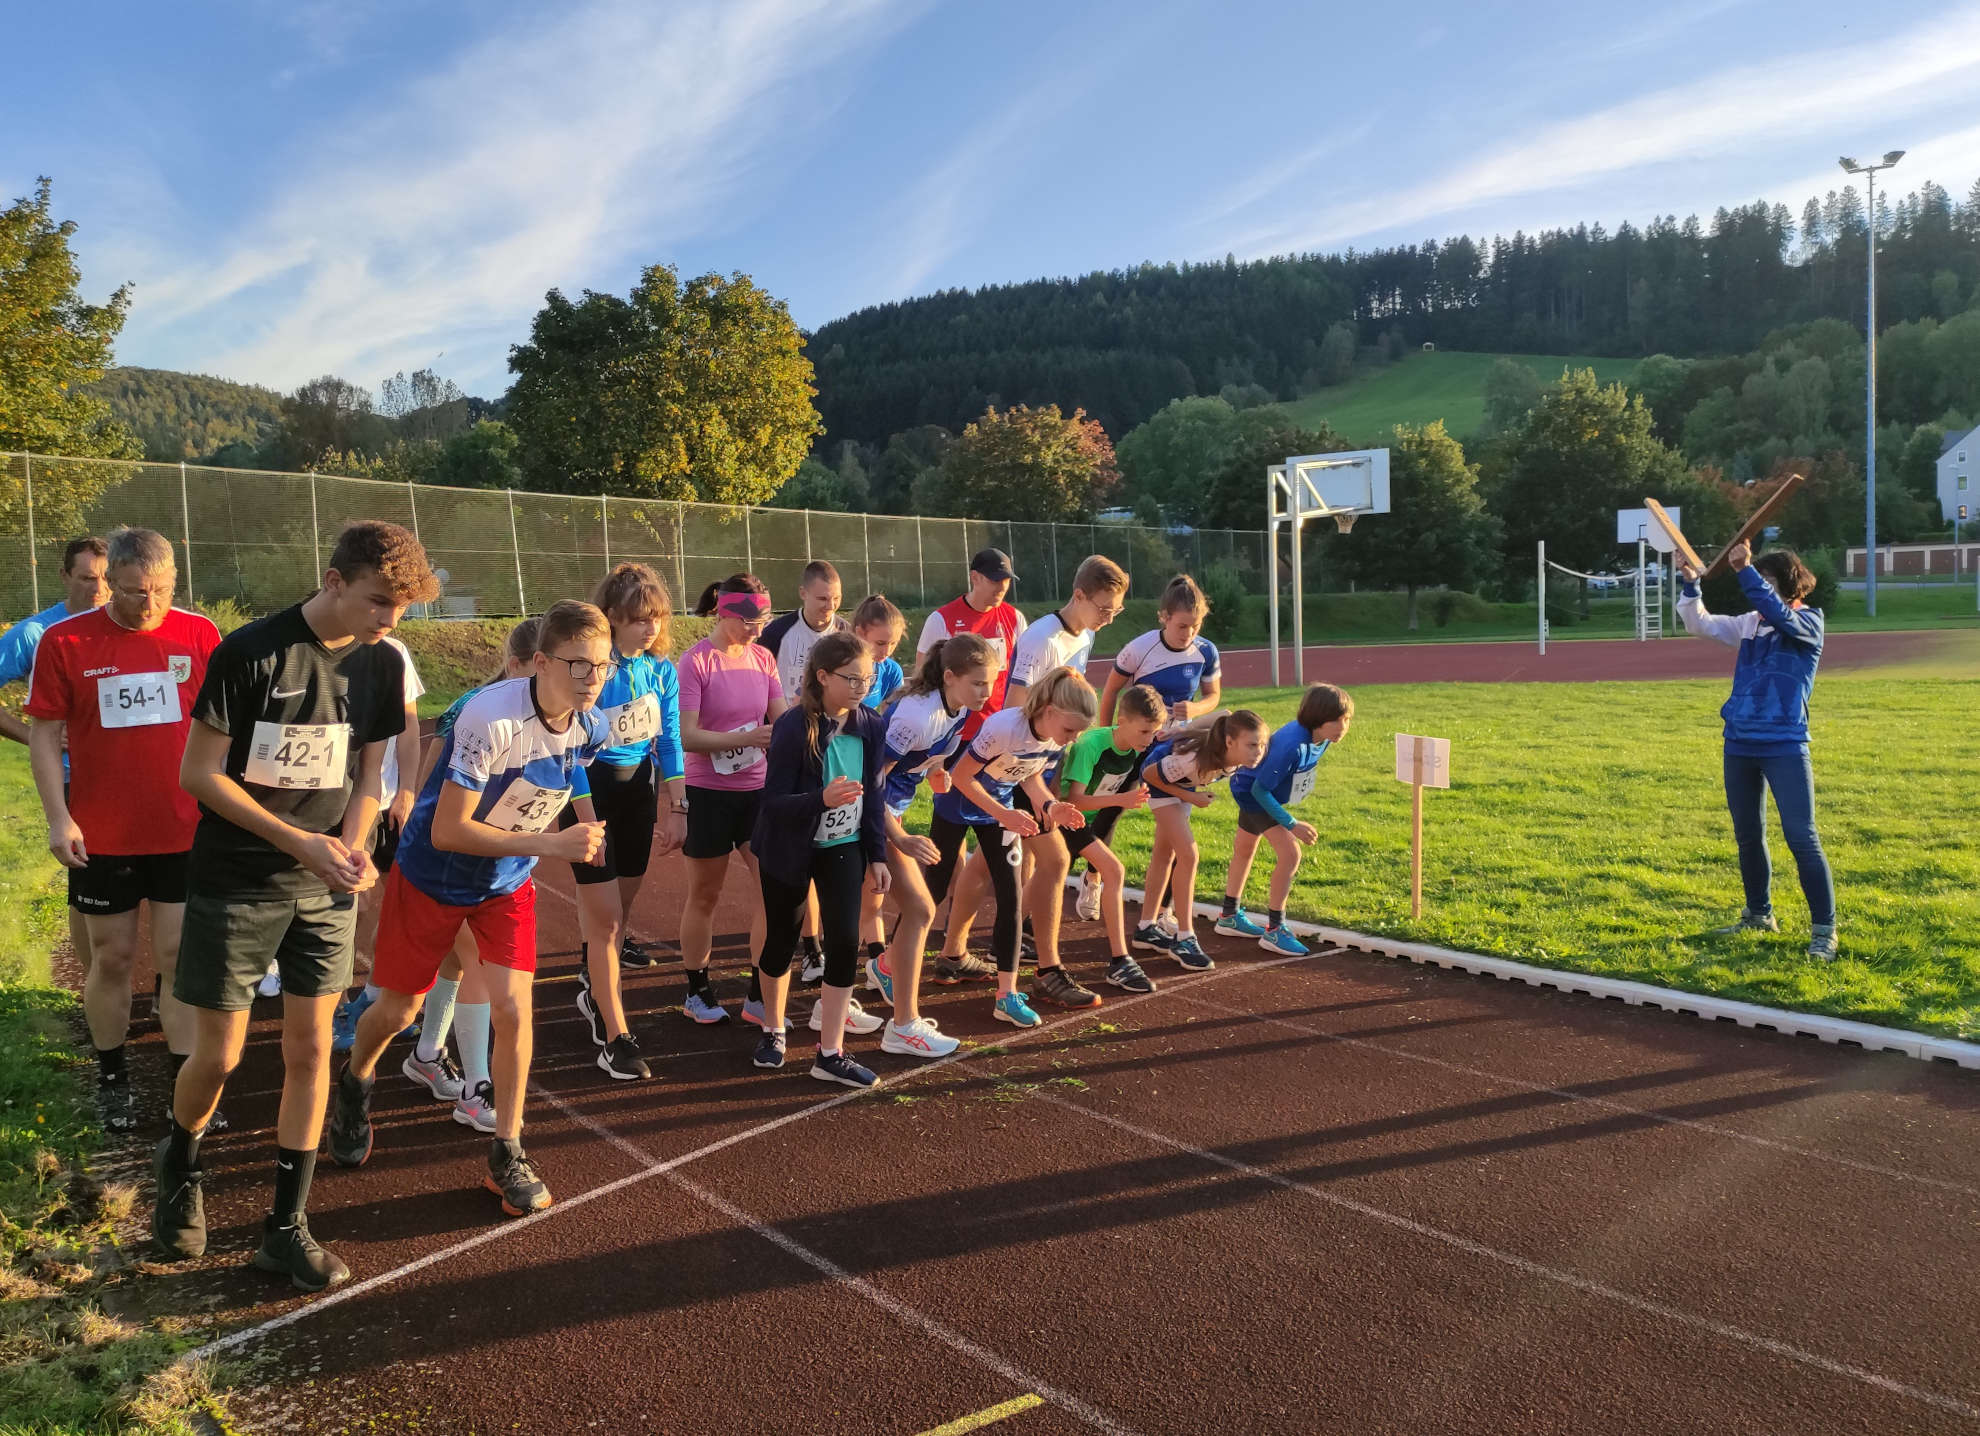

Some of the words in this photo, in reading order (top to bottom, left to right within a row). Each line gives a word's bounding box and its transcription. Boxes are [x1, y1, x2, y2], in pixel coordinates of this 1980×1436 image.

[83, 666, 113, 678] CRAFT
[119, 684, 166, 709] 54-1
[618, 706, 652, 732] 61-1
[274, 741, 335, 768] 42-1
[825, 806, 858, 828] 52-1
